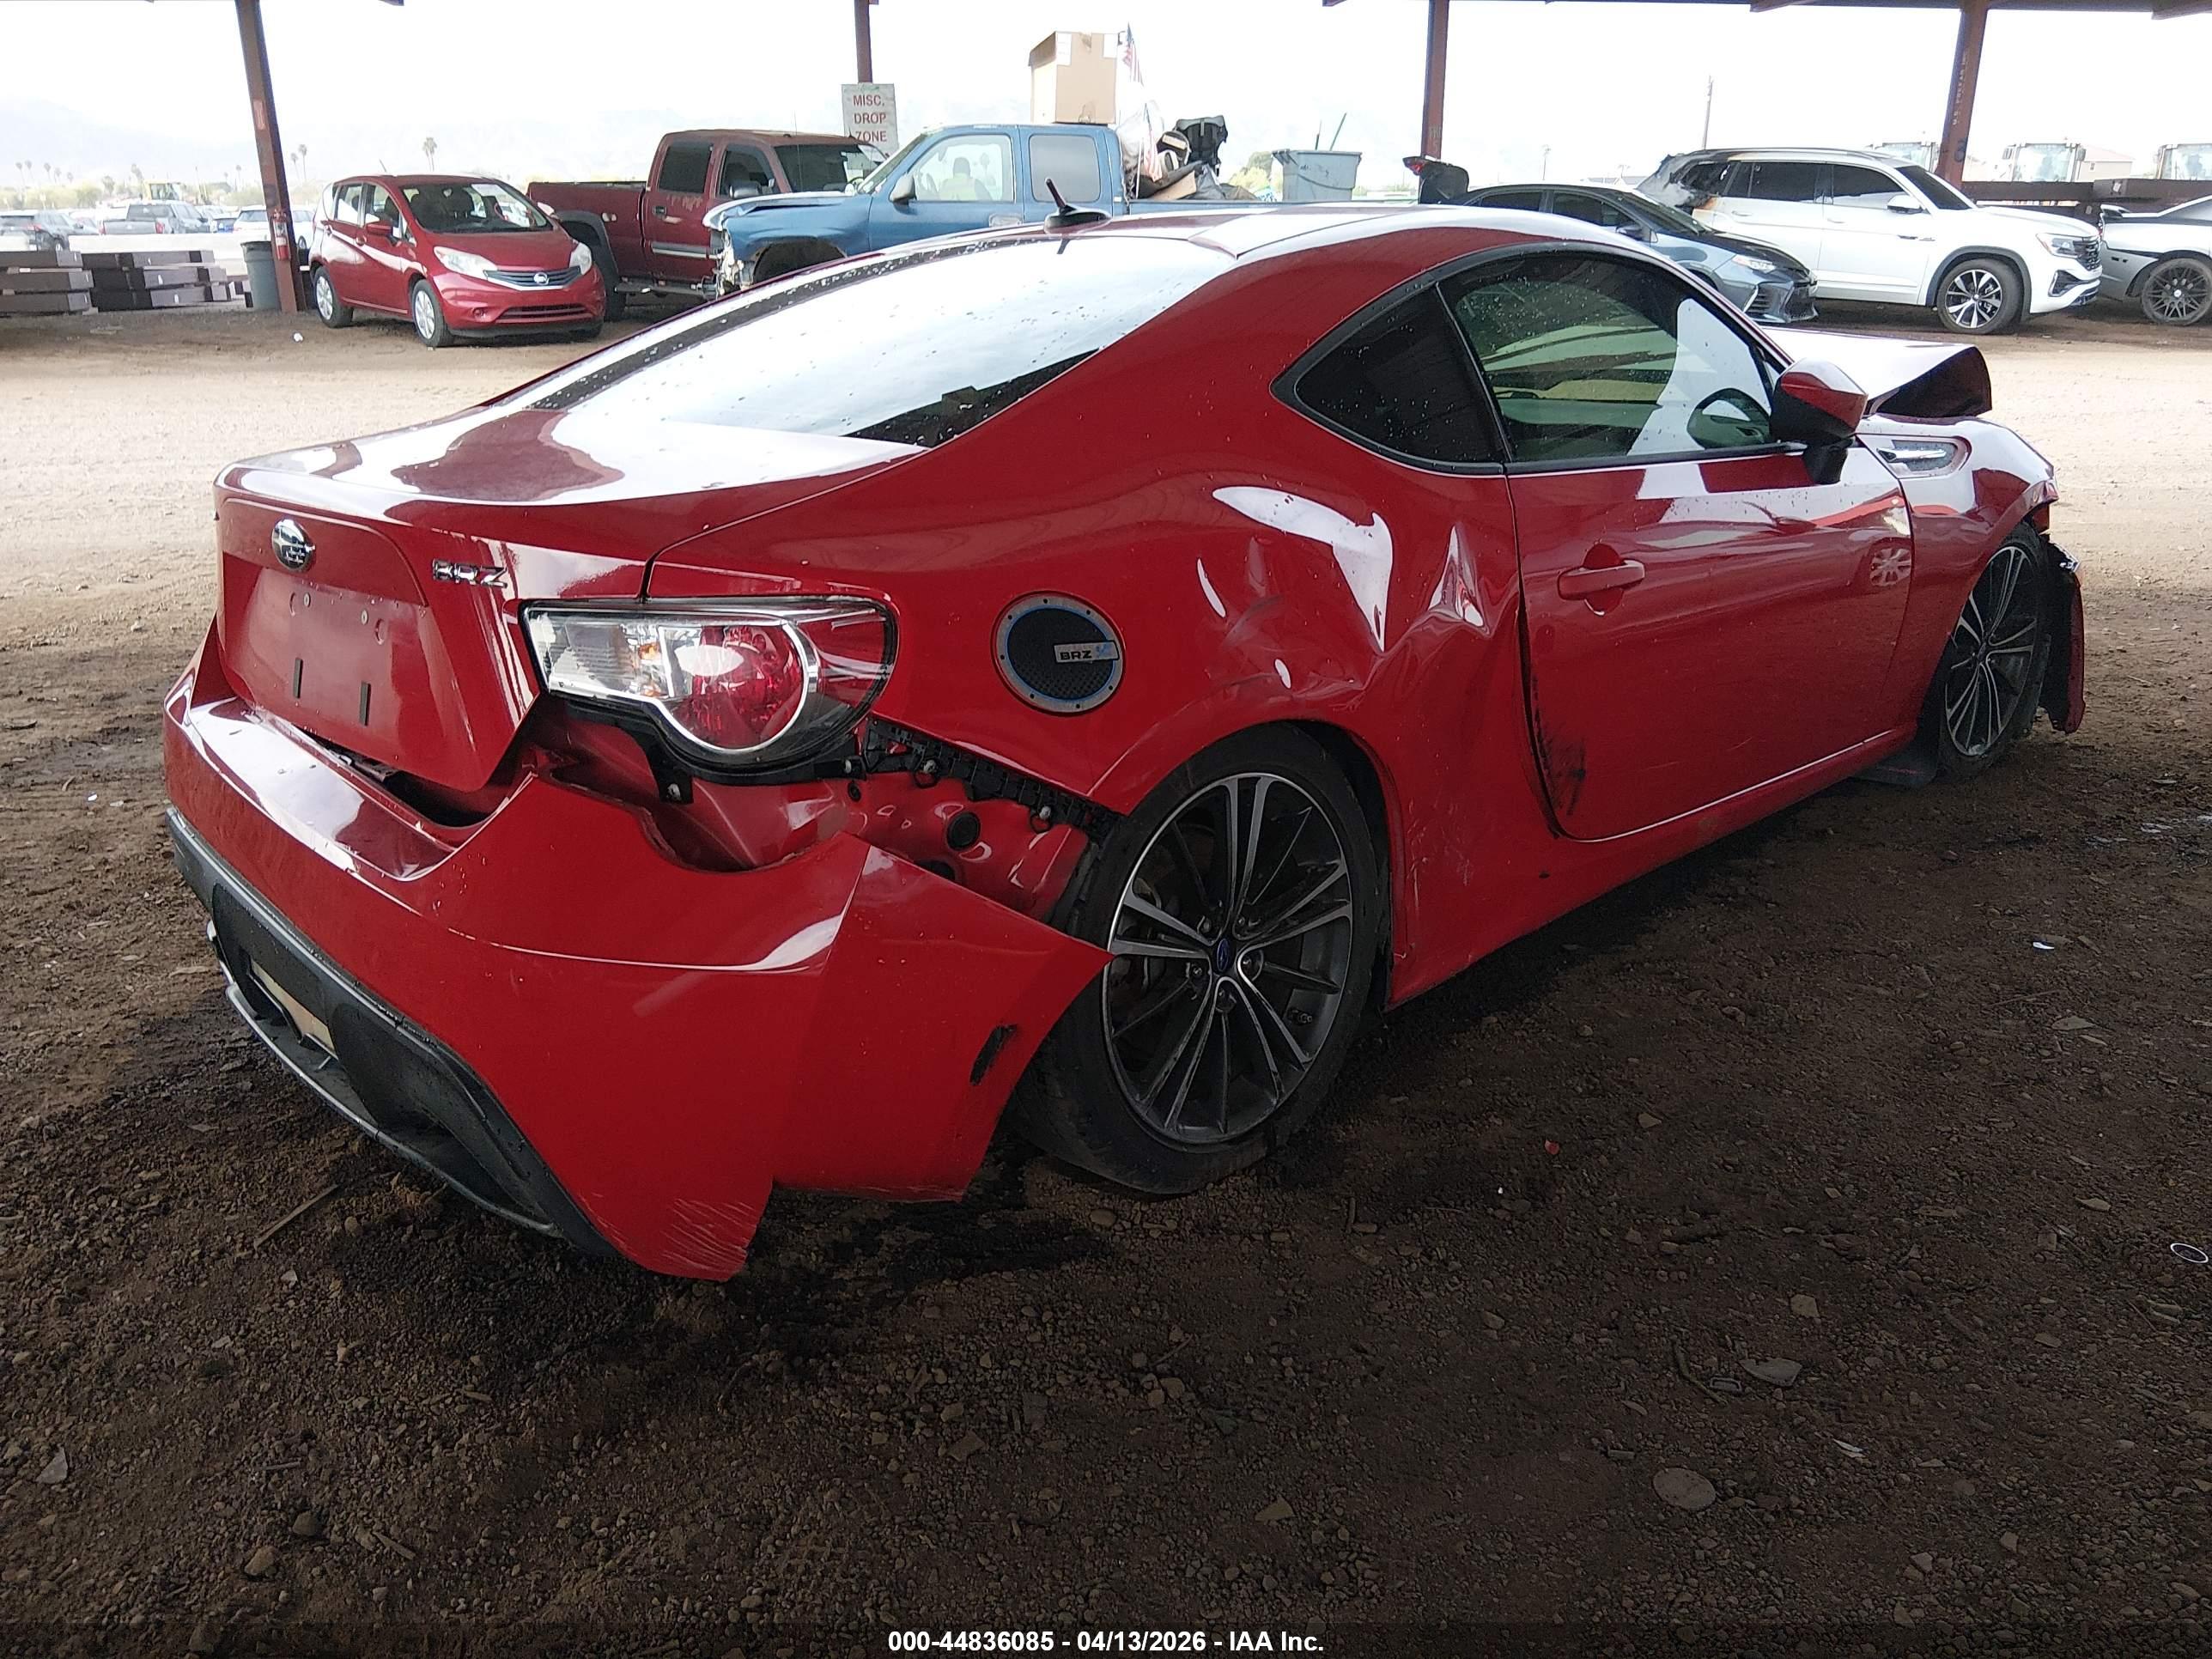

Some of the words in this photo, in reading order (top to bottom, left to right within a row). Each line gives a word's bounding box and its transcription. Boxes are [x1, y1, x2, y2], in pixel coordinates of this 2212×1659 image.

[853, 94, 885, 106] MISC.
[854, 112, 886, 125] DROP
[855, 131, 887, 143] ZONE
[432, 559, 508, 589] BRZ
[1060, 649, 1092, 661] BRZ
